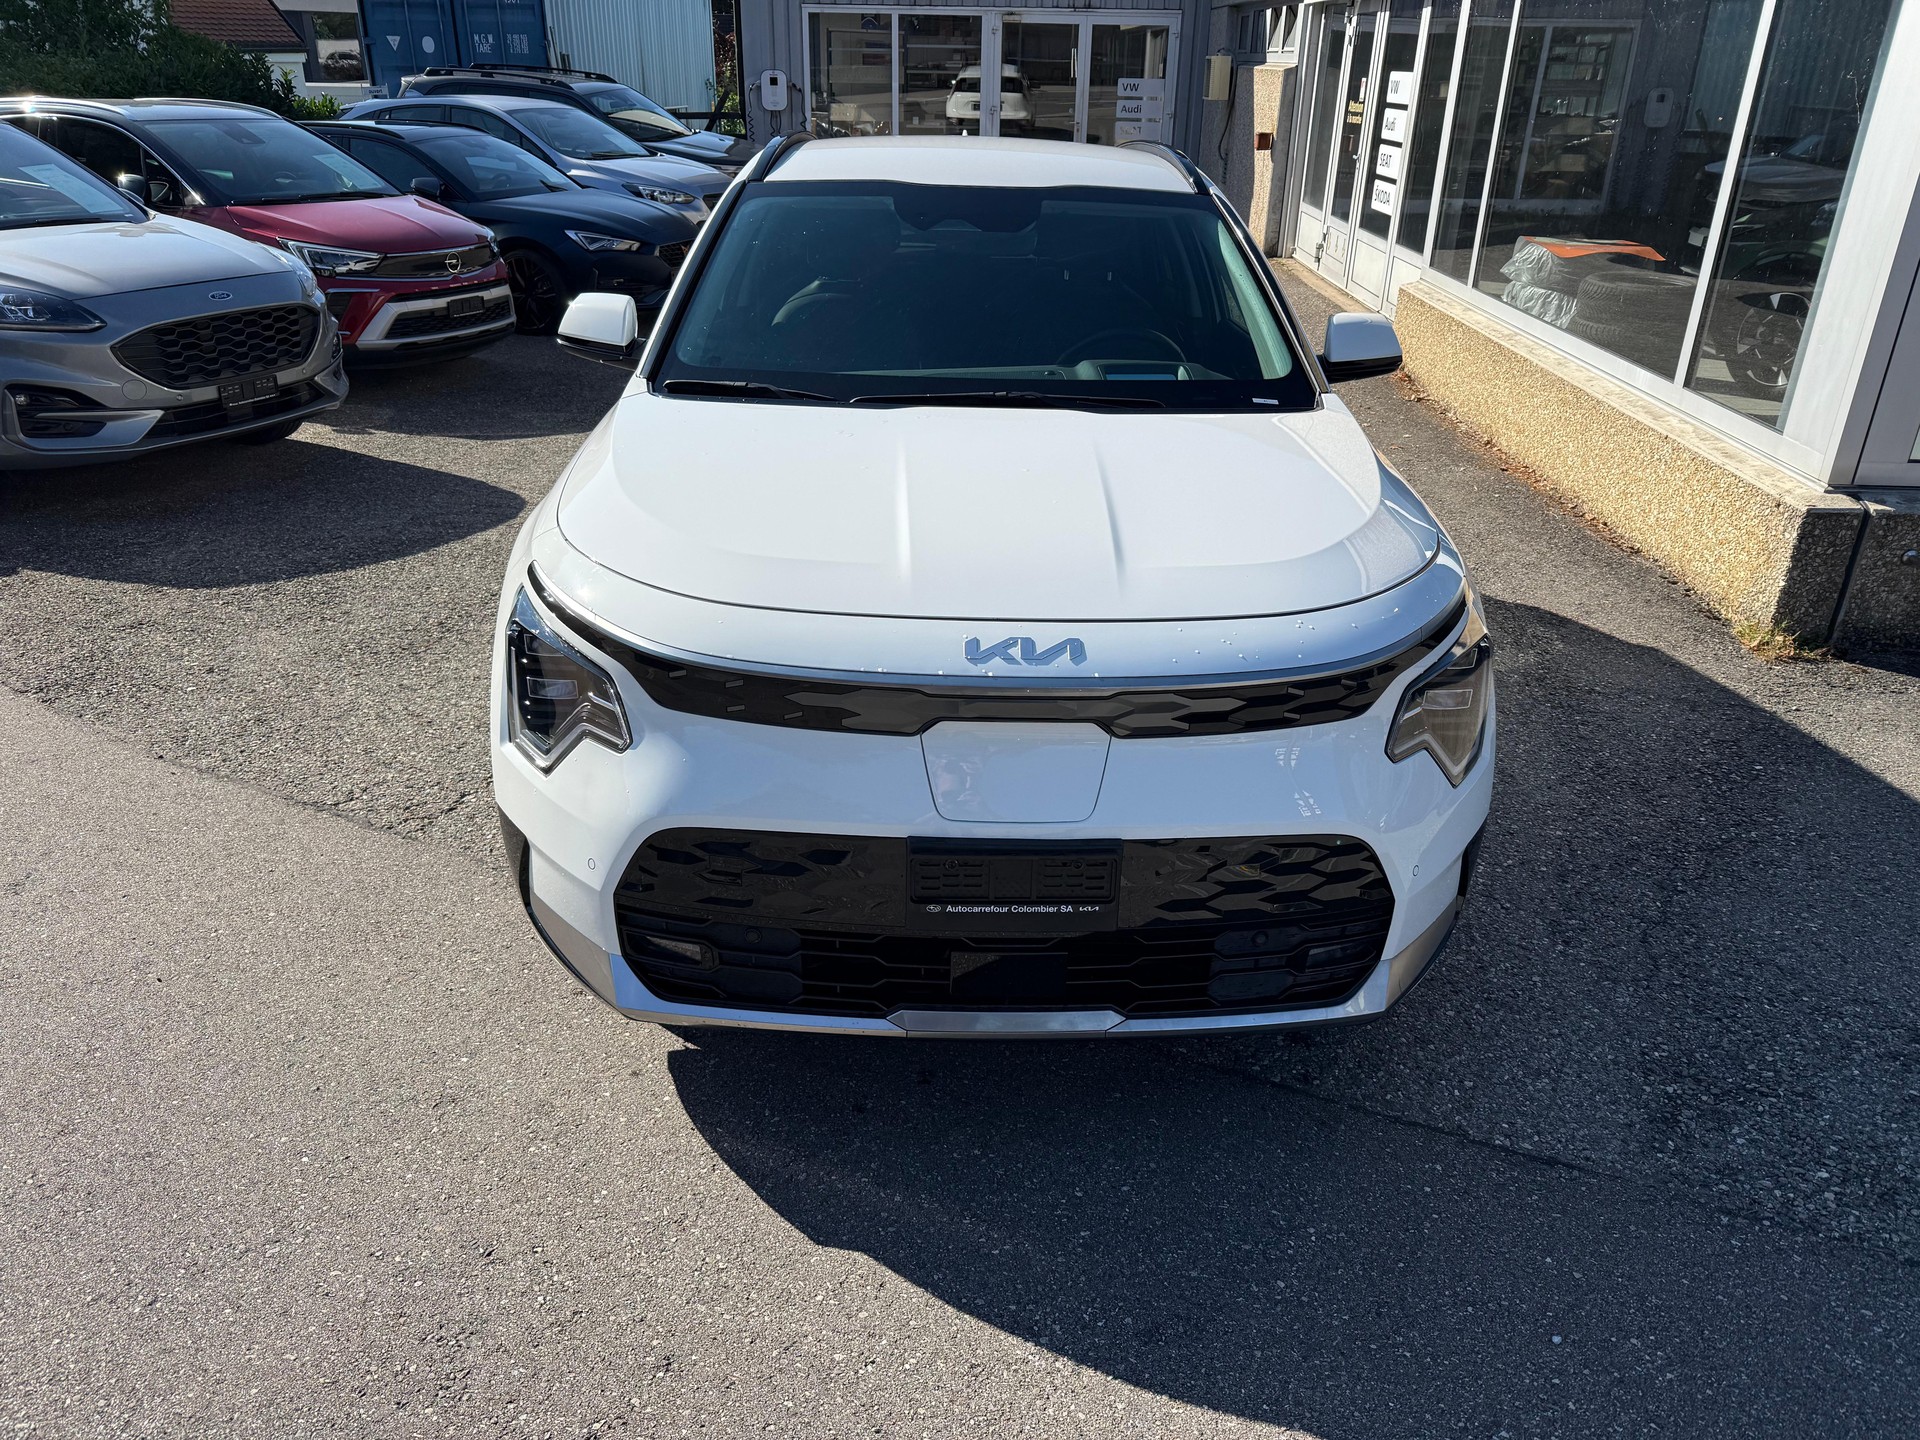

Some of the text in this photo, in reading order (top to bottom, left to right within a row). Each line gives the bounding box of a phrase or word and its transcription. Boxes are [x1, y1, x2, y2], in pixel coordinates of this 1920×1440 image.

[475, 43, 492, 53] TARE
[1122, 83, 1140, 92] VW
[1390, 80, 1401, 95] VW
[1120, 105, 1142, 113] Audi
[1384, 117, 1397, 131] Audi
[1379, 152, 1392, 168] SEAT
[963, 636, 1087, 666] KIA
[945, 904, 1009, 913] Autocarrefour
[1011, 904, 1058, 913] Colombier
[1060, 905, 1073, 913] SA
